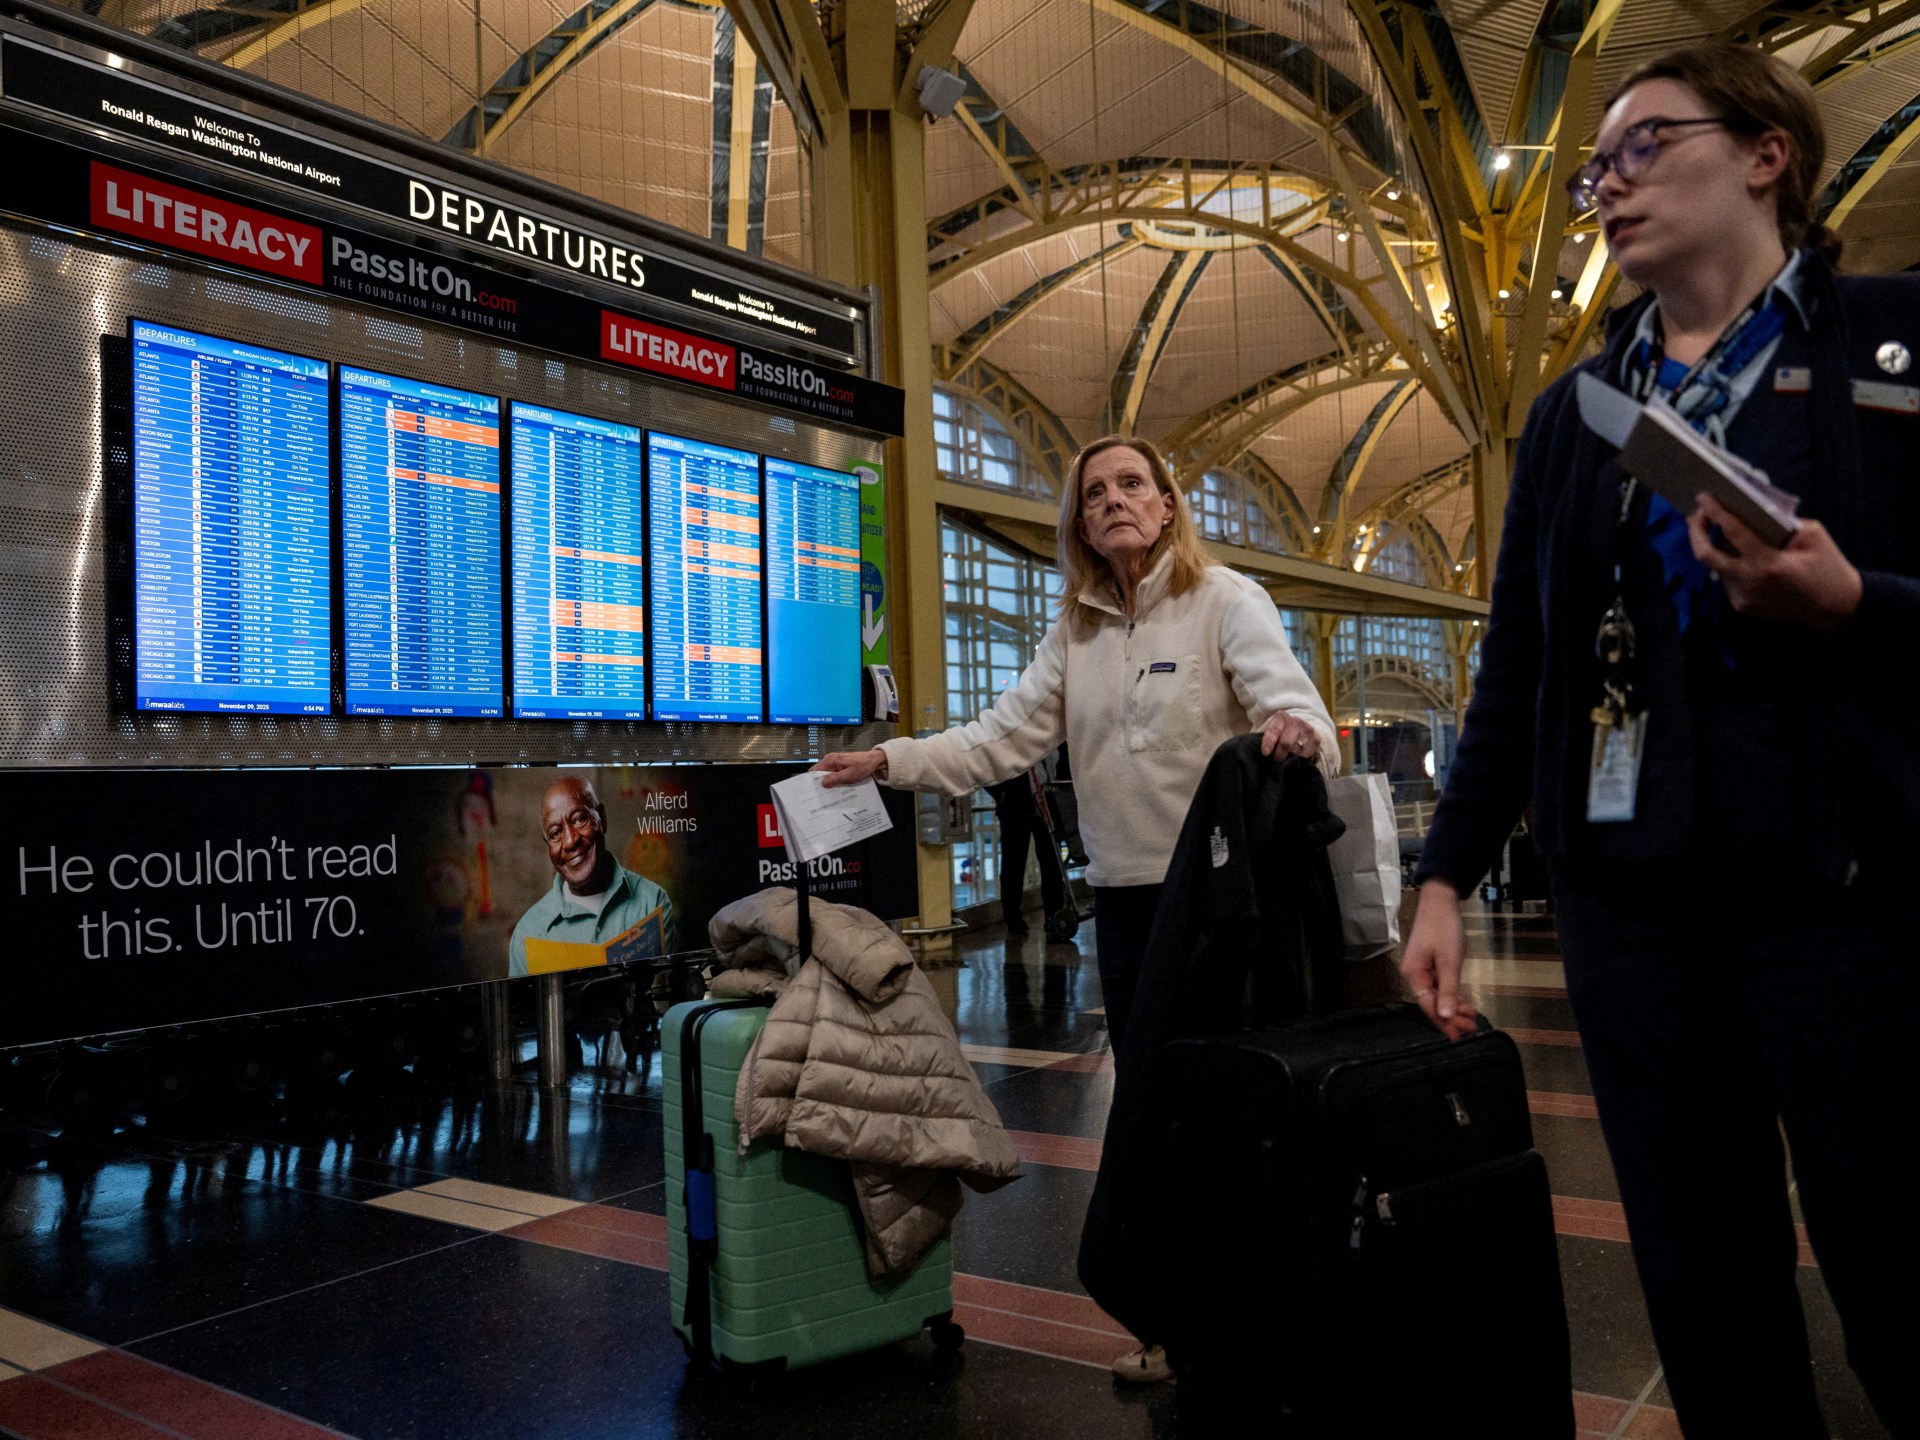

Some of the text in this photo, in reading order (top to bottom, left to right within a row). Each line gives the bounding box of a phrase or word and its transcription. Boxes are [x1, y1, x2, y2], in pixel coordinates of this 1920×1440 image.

[102, 100, 340, 186] Ronald Reagan Washington National Airport
[195, 116, 260, 147] Welcome To
[106, 180, 311, 267] LITERACY
[409, 180, 645, 288] DEPARTURES
[331, 235, 517, 314] PassItOn.com
[333, 275, 517, 333] THE FOUNDATION FOR A BETTER LIFE
[692, 288, 816, 335] Ronald Reagan Washington National Airport
[739, 293, 774, 312] Welcome To
[138, 327, 284, 365] DEPARTURES REAGAN NATIONAL
[610, 323, 729, 378] LITERACY
[344, 372, 391, 387] DEPARTURES
[740, 351, 855, 404] PassItOn.com
[515, 406, 552, 421] DEPARTURES
[741, 382, 753, 393] THE
[756, 386, 798, 404] FOUNDATION
[818, 404, 841, 415] BETTER
[844, 409, 854, 418] LIFE
[140, 440, 171, 449] BIRMINGHAM
[645, 791, 688, 811] Alferd
[636, 815, 698, 835] Williams
[19, 833, 398, 896] He couldn't read
[837, 880, 857, 890] BETTER
[78, 896, 365, 960] this. Until 70.
